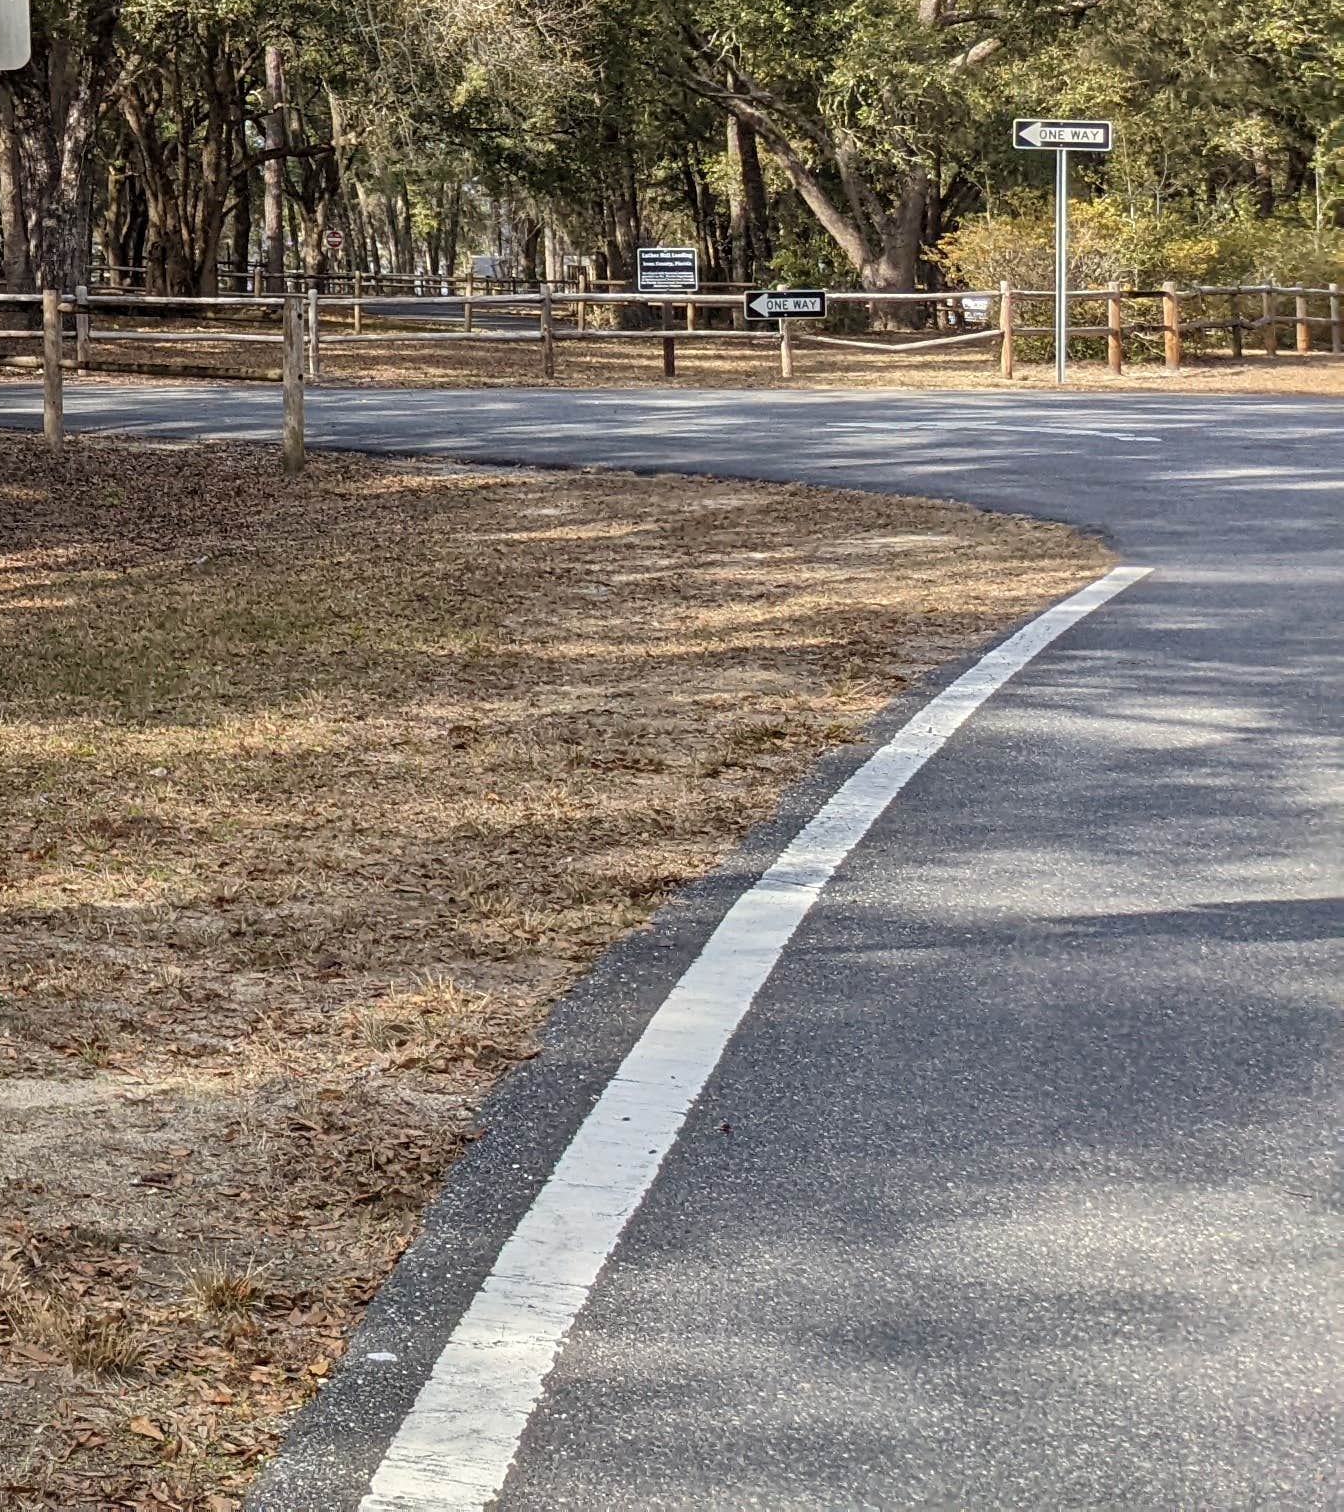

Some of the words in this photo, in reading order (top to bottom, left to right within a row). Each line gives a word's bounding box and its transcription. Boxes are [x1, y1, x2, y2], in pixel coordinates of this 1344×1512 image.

[1039, 129, 1065, 140] ONE
[1070, 130, 1100, 141] WAY
[766, 299, 789, 310] ONE
[792, 299, 817, 310] WAY
